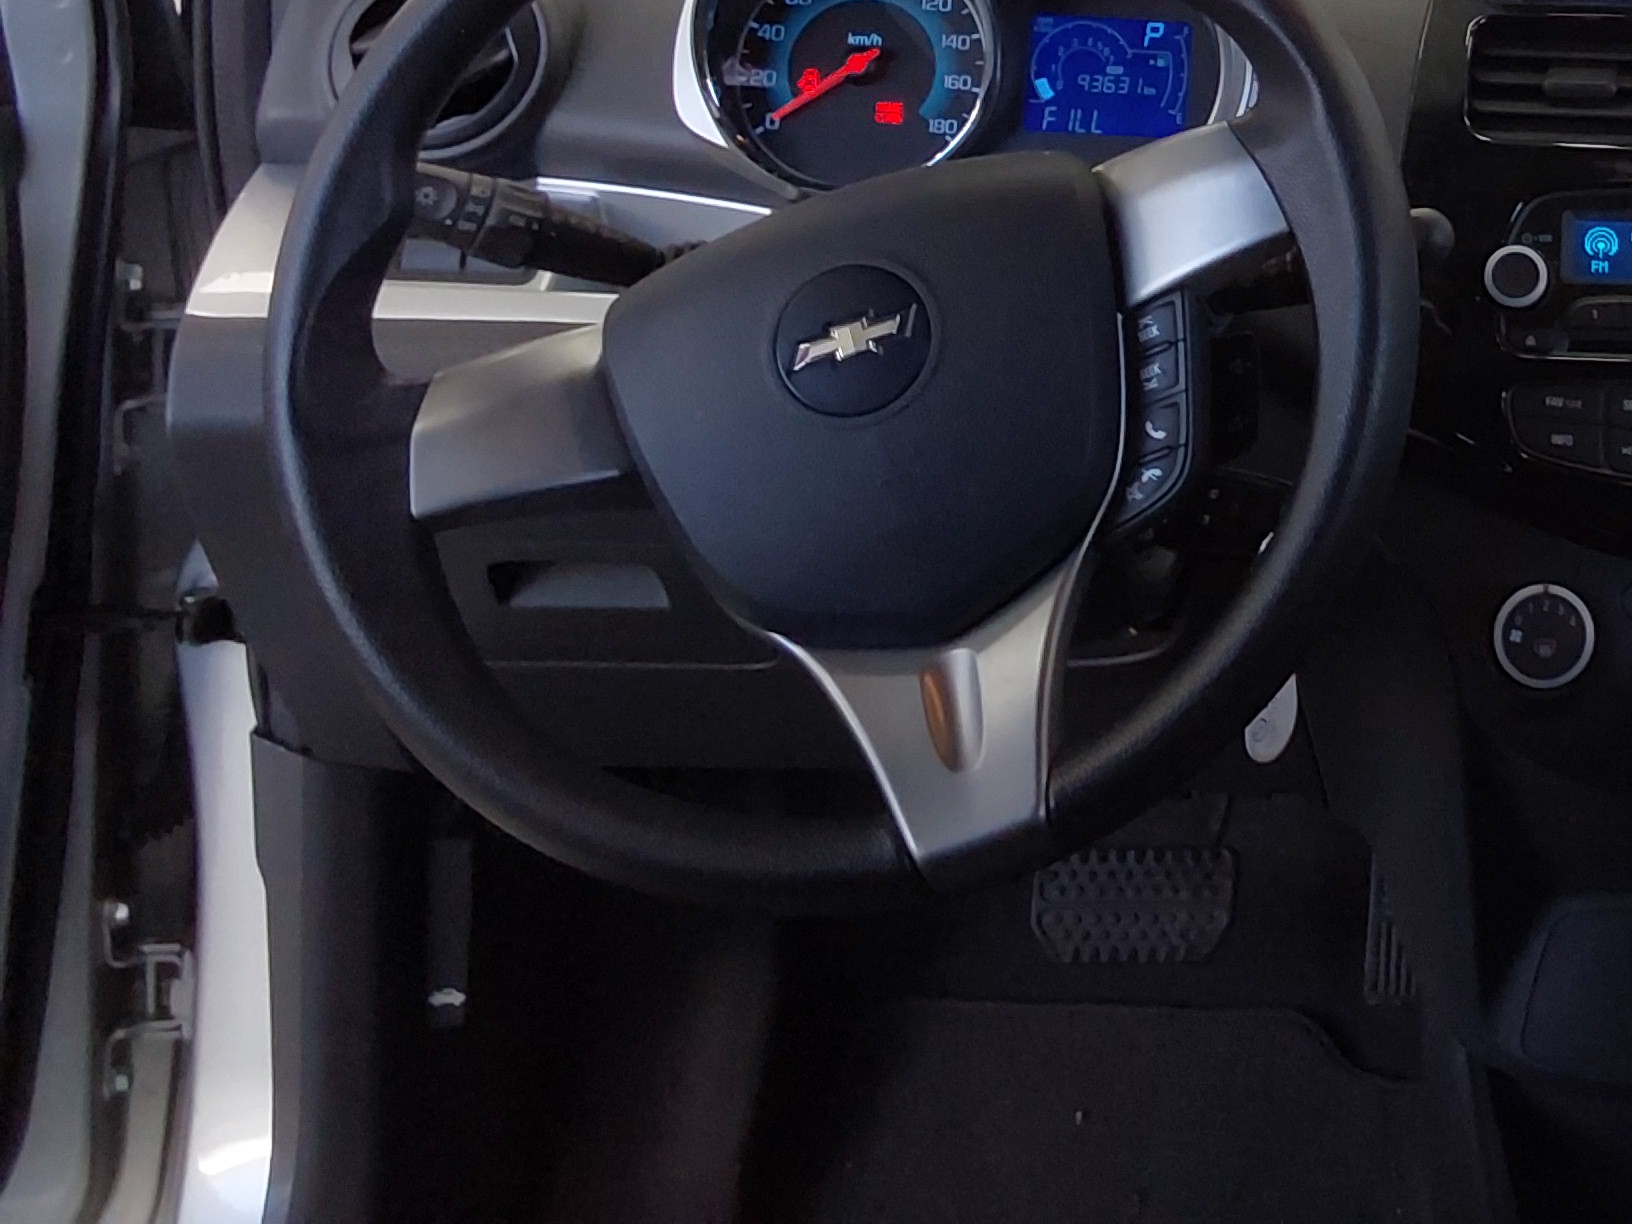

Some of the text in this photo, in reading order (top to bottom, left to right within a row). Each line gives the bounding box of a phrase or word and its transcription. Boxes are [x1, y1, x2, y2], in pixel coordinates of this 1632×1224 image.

[757, 23, 785, 42] 40
[847, 32, 884, 48] km/h
[1143, 22, 1165, 48] P
[941, 34, 971, 51] 140
[749, 69, 777, 87] 20
[944, 74, 973, 91] 160
[1077, 74, 1142, 95] 93631
[764, 112, 781, 131] 0
[928, 118, 958, 135] 180
[1042, 106, 1103, 134] FILL
[1590, 259, 1609, 274] FM
